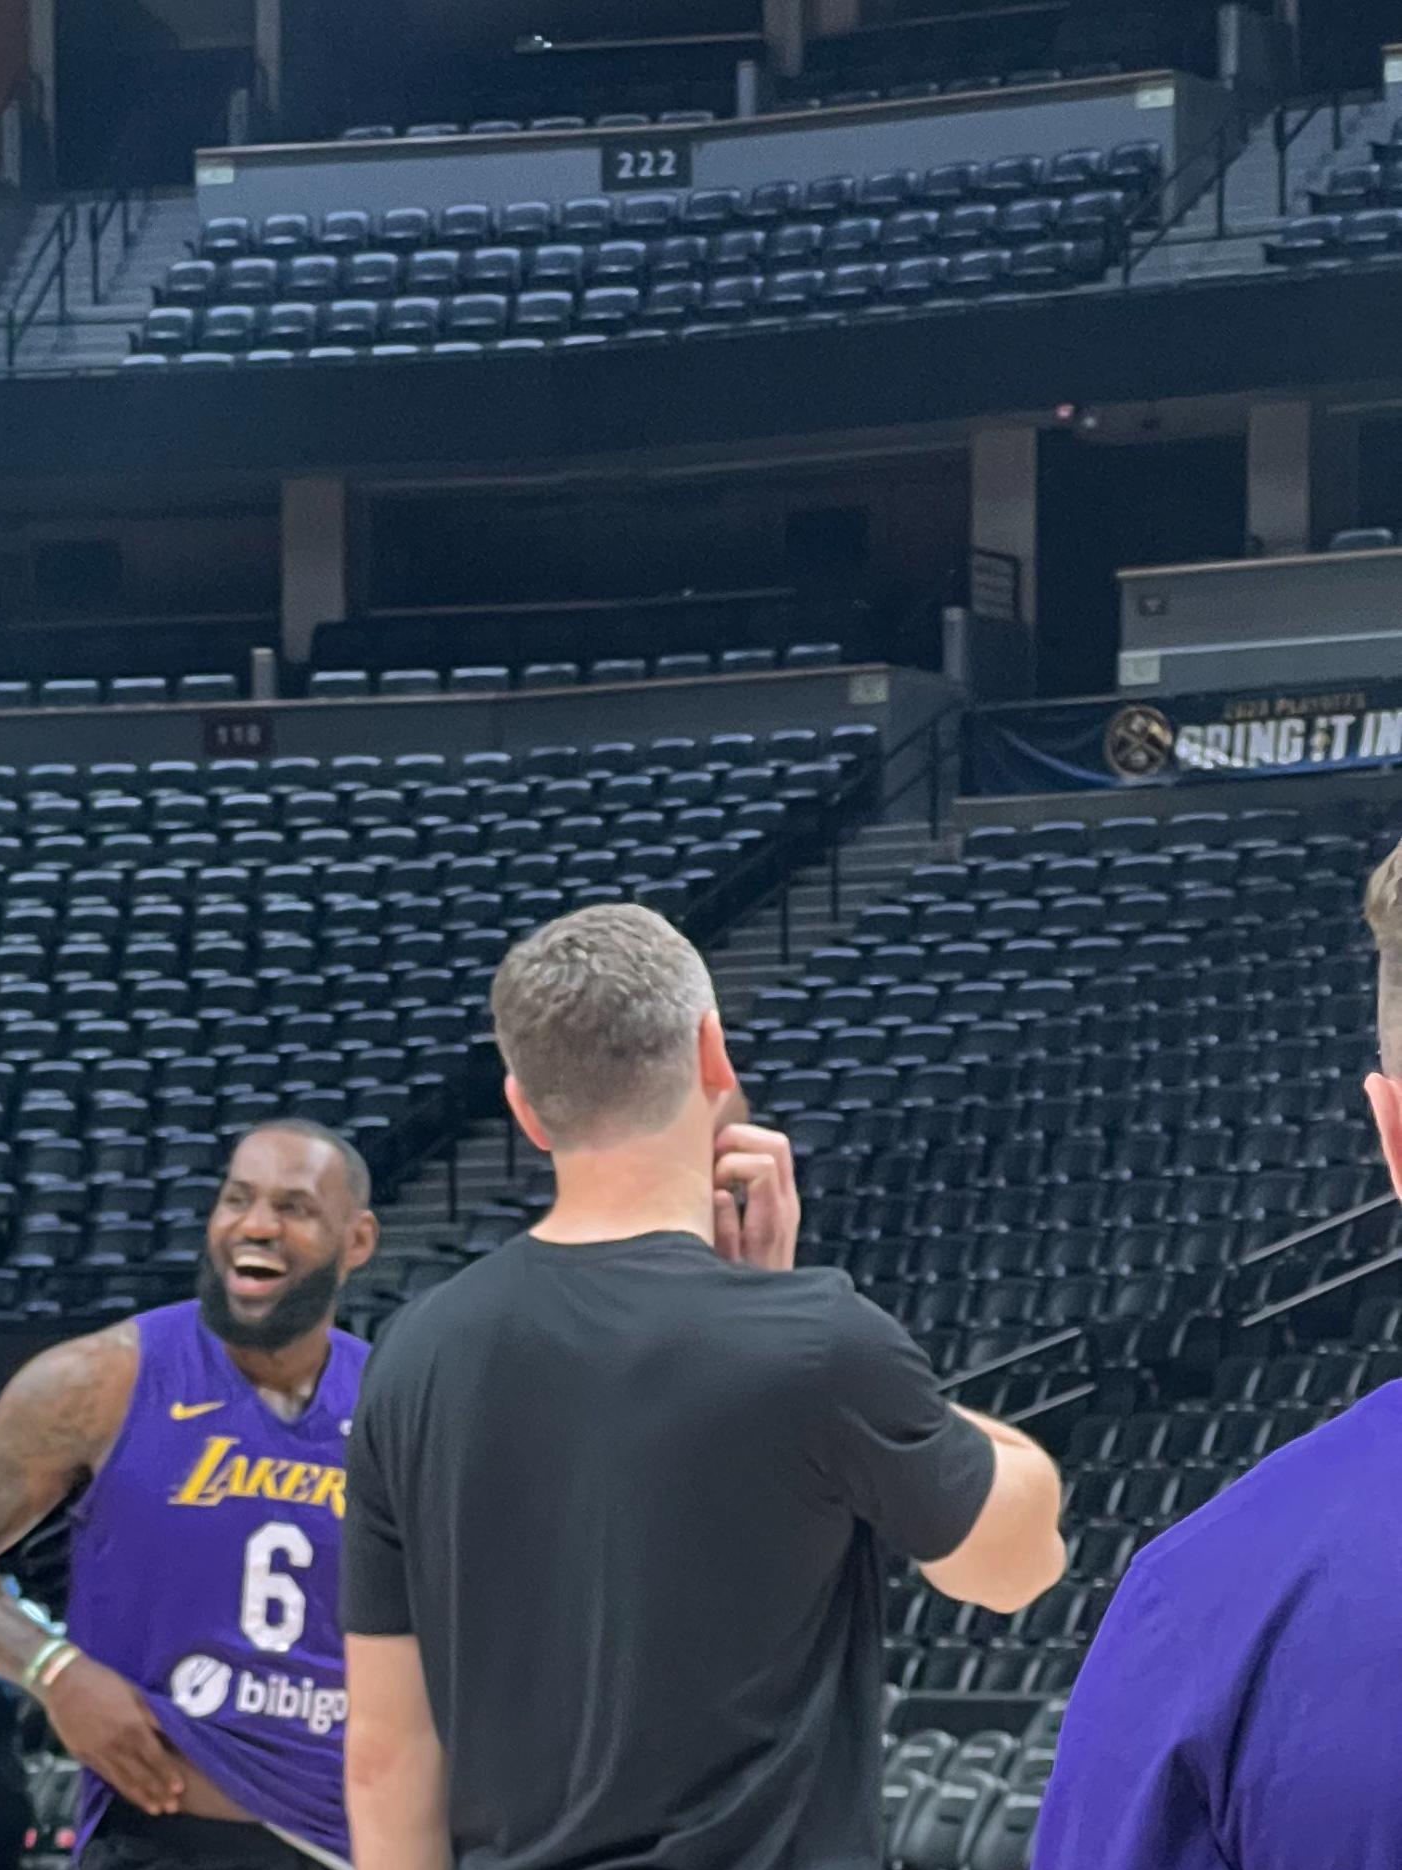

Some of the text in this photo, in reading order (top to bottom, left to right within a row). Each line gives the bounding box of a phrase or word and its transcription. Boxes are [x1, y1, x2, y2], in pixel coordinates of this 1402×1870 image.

[618, 150, 676, 178] 222
[167, 1436, 346, 1519] LAKER
[240, 1521, 314, 1653] 6
